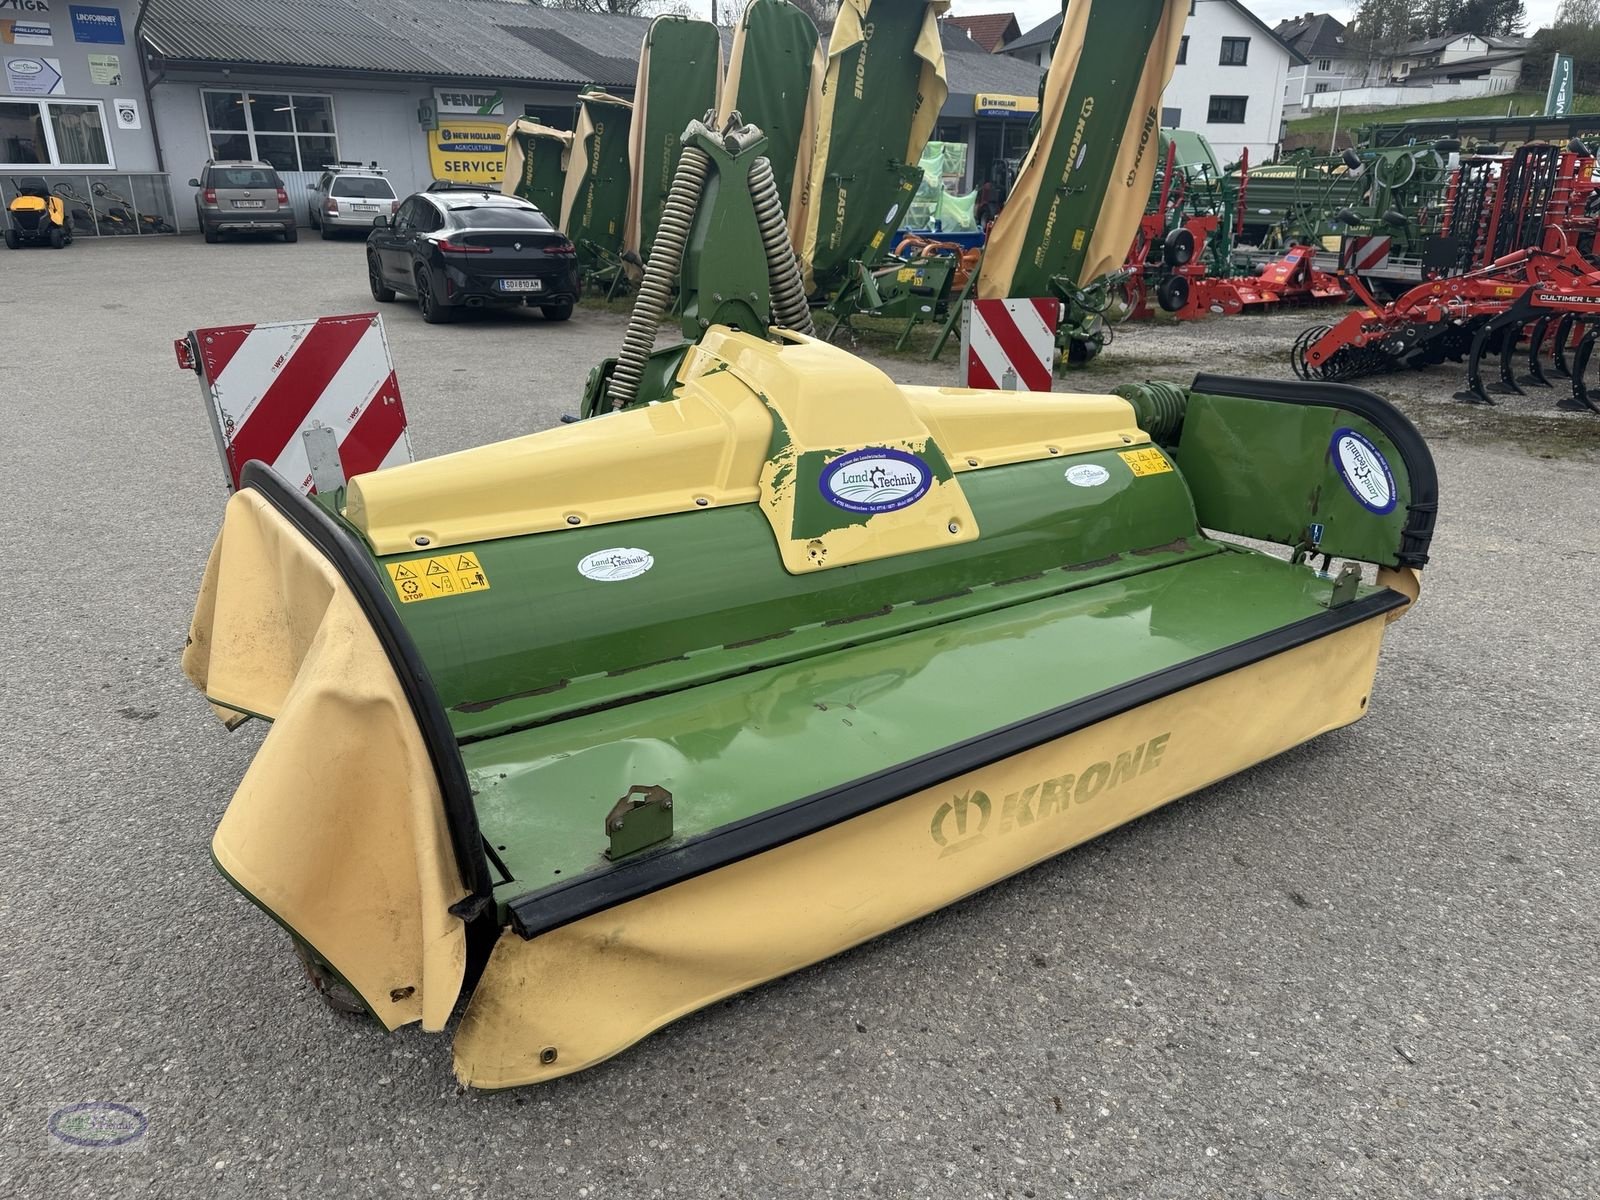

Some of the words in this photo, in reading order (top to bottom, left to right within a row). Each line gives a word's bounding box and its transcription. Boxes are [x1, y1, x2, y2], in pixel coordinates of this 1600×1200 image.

[854, 40, 868, 100] KRONE
[1556, 60, 1569, 114] MERLO
[440, 93, 494, 107] FENDT
[452, 132, 469, 140] NEW
[470, 132, 501, 140] HOLLAND
[1135, 106, 1158, 170] KRONE
[592, 135, 602, 176] KRONE
[1061, 116, 1086, 183] KRONE
[444, 161, 503, 173] SERVICE
[526, 150, 534, 186] KRONE
[1540, 294, 1584, 302] CULTIMER
[273, 354, 285, 369] WGF
[349, 406, 360, 419] WGF
[1345, 439, 1369, 472] Technik
[842, 470, 869, 484] Land
[878, 472, 917, 488] Technik
[1361, 478, 1379, 500] Land
[591, 558, 610, 567] Land
[616, 554, 645, 566] Technik
[403, 592, 424, 601] STOP
[999, 732, 1172, 834] KRONE
